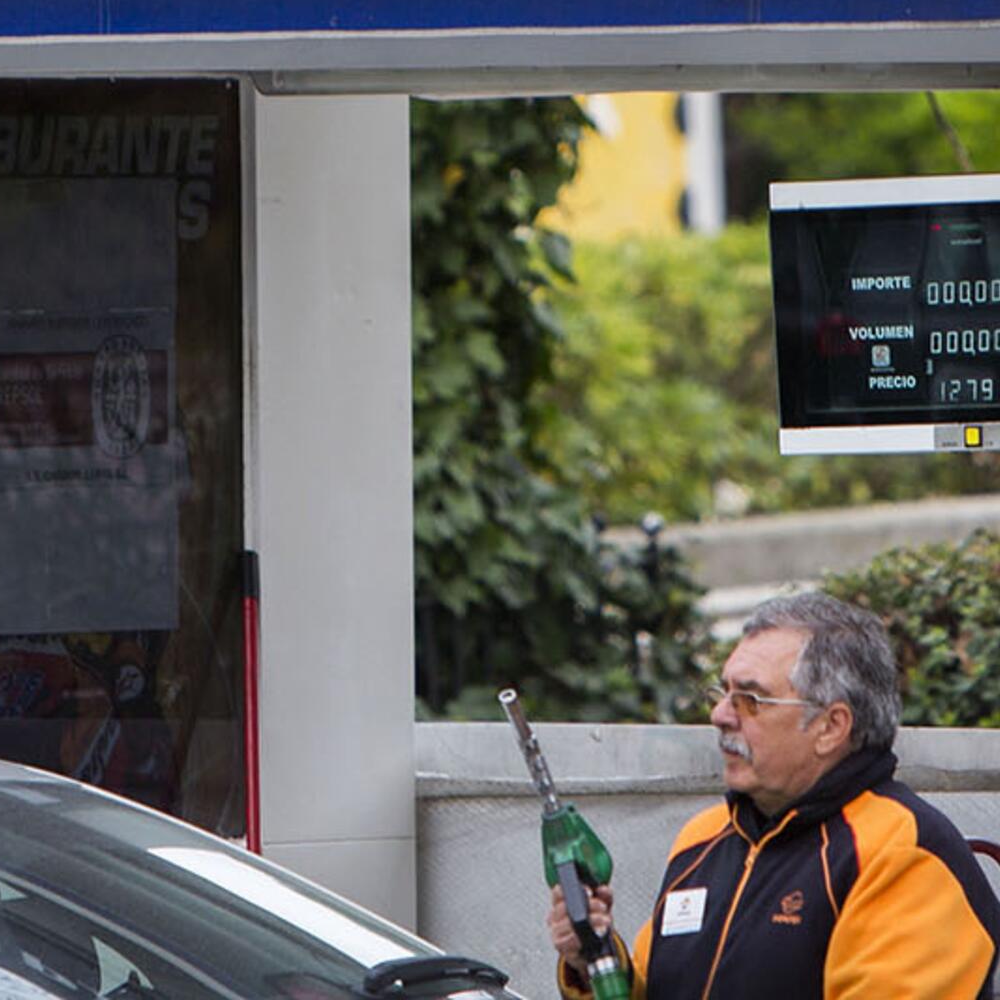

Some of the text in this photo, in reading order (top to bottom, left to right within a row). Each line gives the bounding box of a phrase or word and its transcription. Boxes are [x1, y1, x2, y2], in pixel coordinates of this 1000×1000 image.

[851, 276, 912, 291] IMPORTE
[849, 325, 914, 341] VOLUMEN
[869, 375, 917, 390] PRECIO
